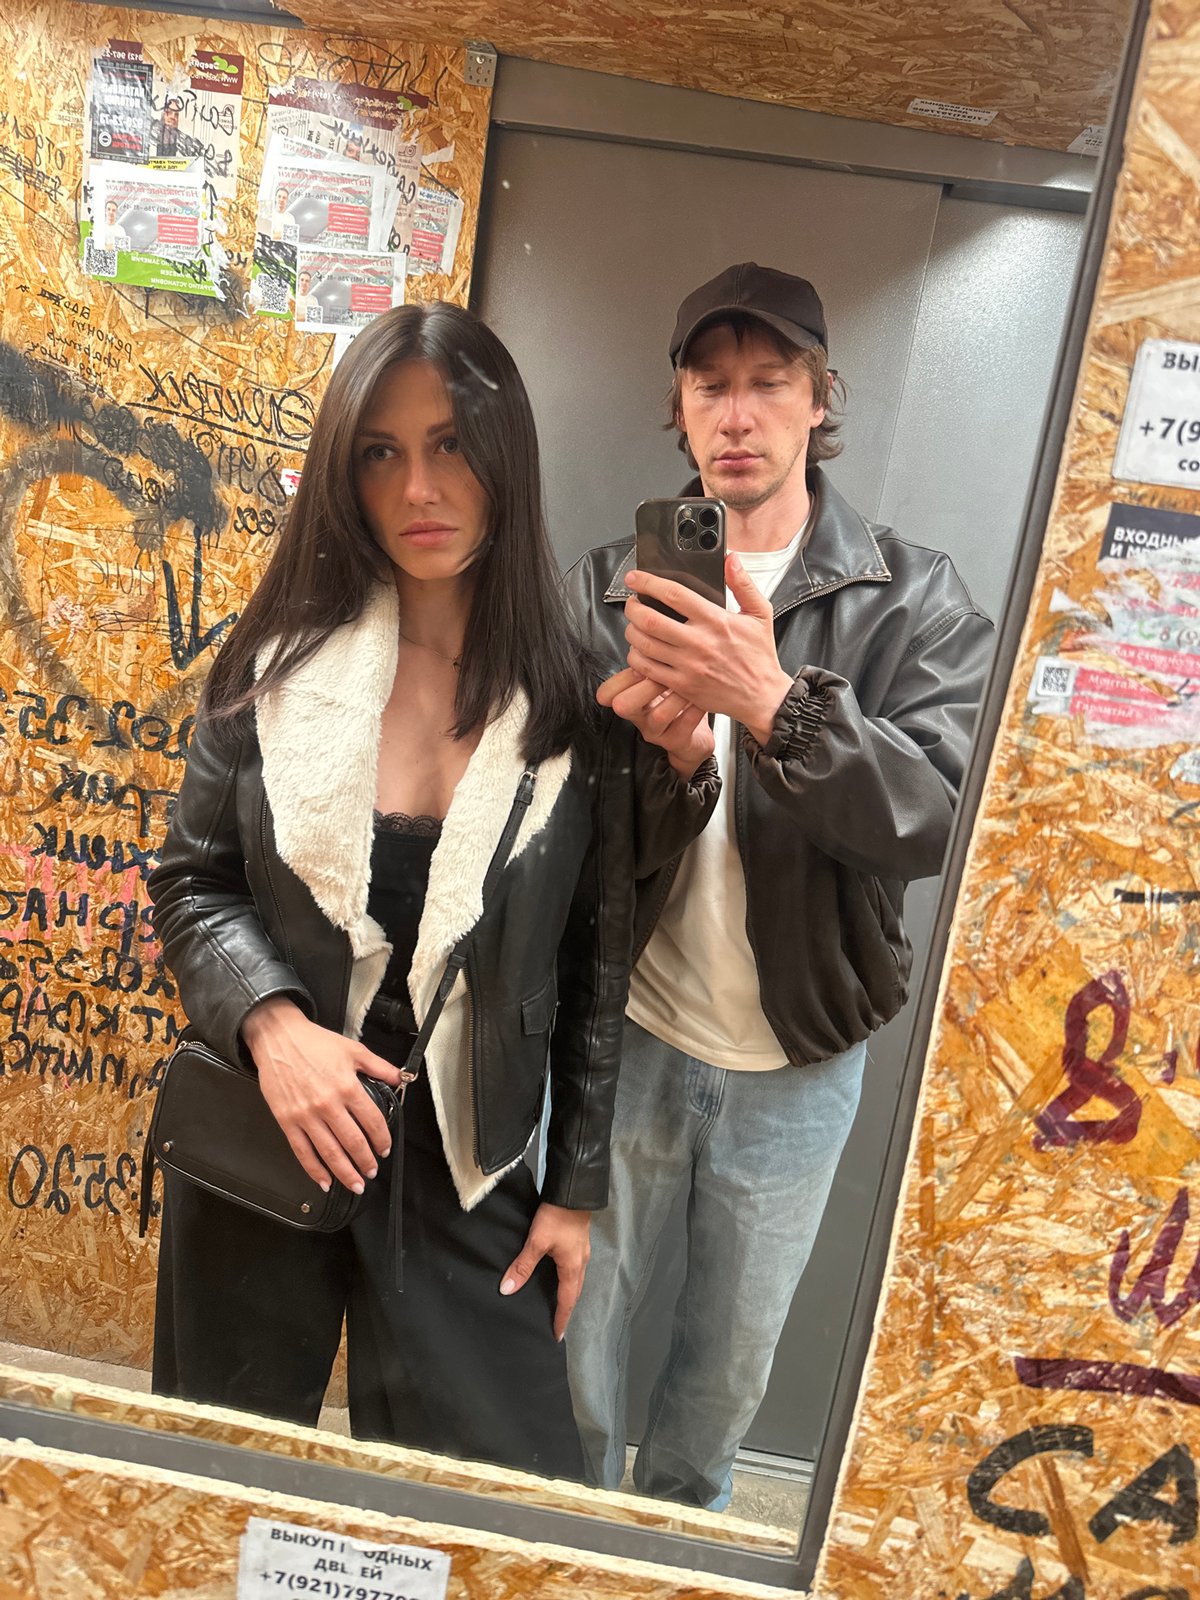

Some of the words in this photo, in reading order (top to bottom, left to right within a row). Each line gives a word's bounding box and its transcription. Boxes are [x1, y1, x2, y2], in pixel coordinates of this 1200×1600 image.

[1109, 542, 1123, 557] И
[1088, 674, 1138, 691] Монтаж
[270, 1527, 335, 1552] ВЫКУП
[260, 1570, 420, 1600] +7(921)7977
